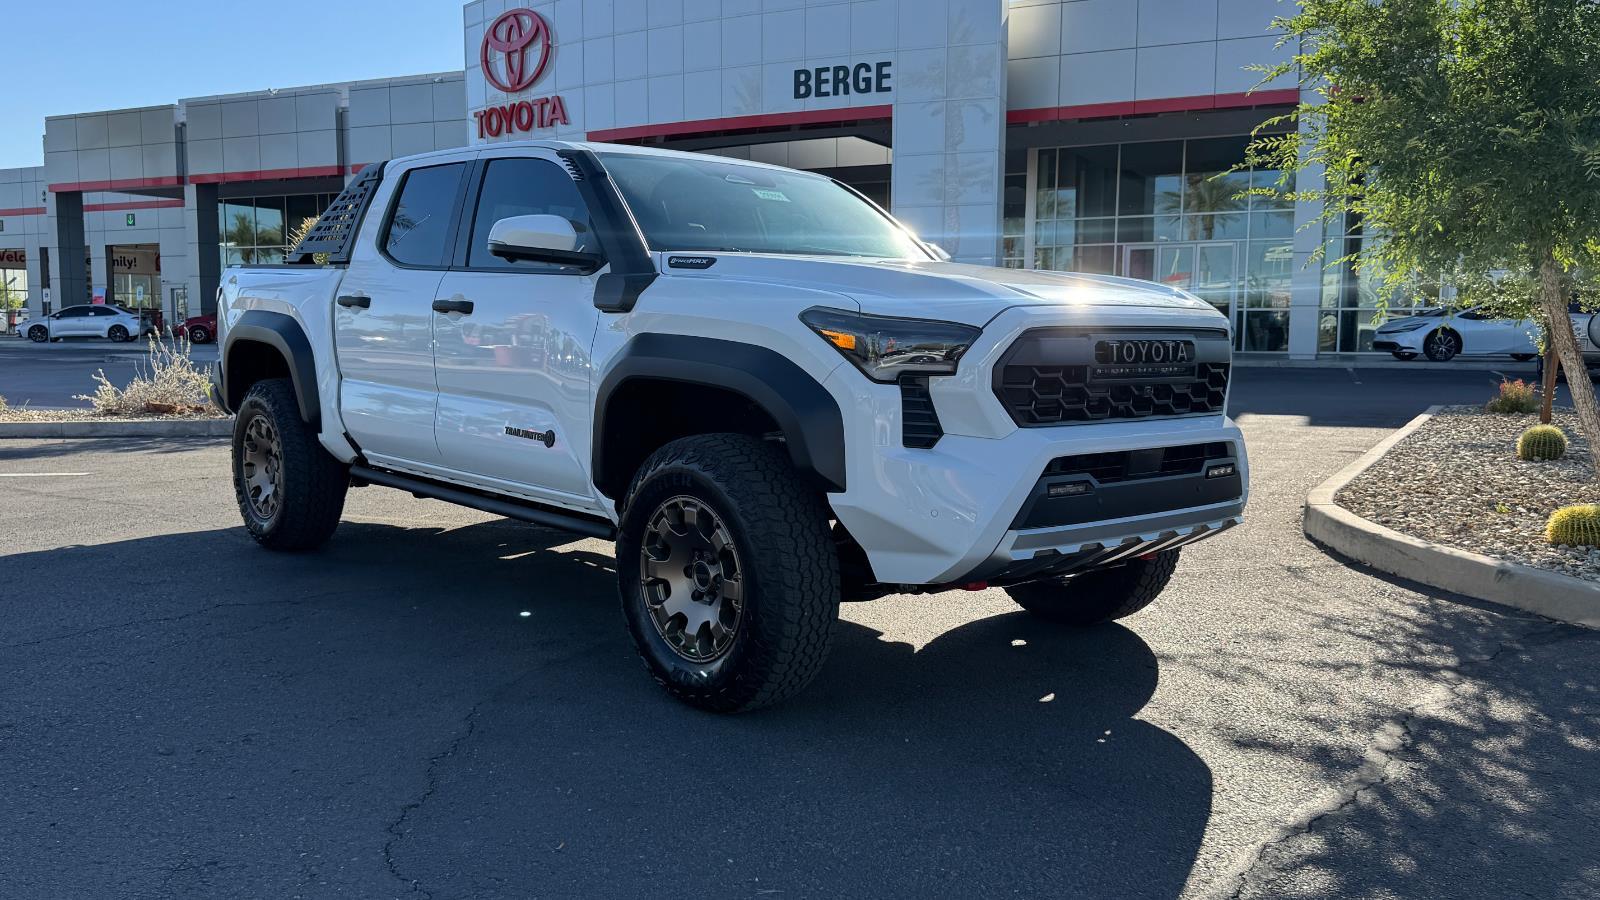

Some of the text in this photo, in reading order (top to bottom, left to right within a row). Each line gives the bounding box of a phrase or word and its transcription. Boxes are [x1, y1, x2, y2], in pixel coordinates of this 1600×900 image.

[794, 61, 892, 99] BERGE
[474, 96, 569, 139] TOYOTA
[1109, 343, 1187, 362] TOYOTA
